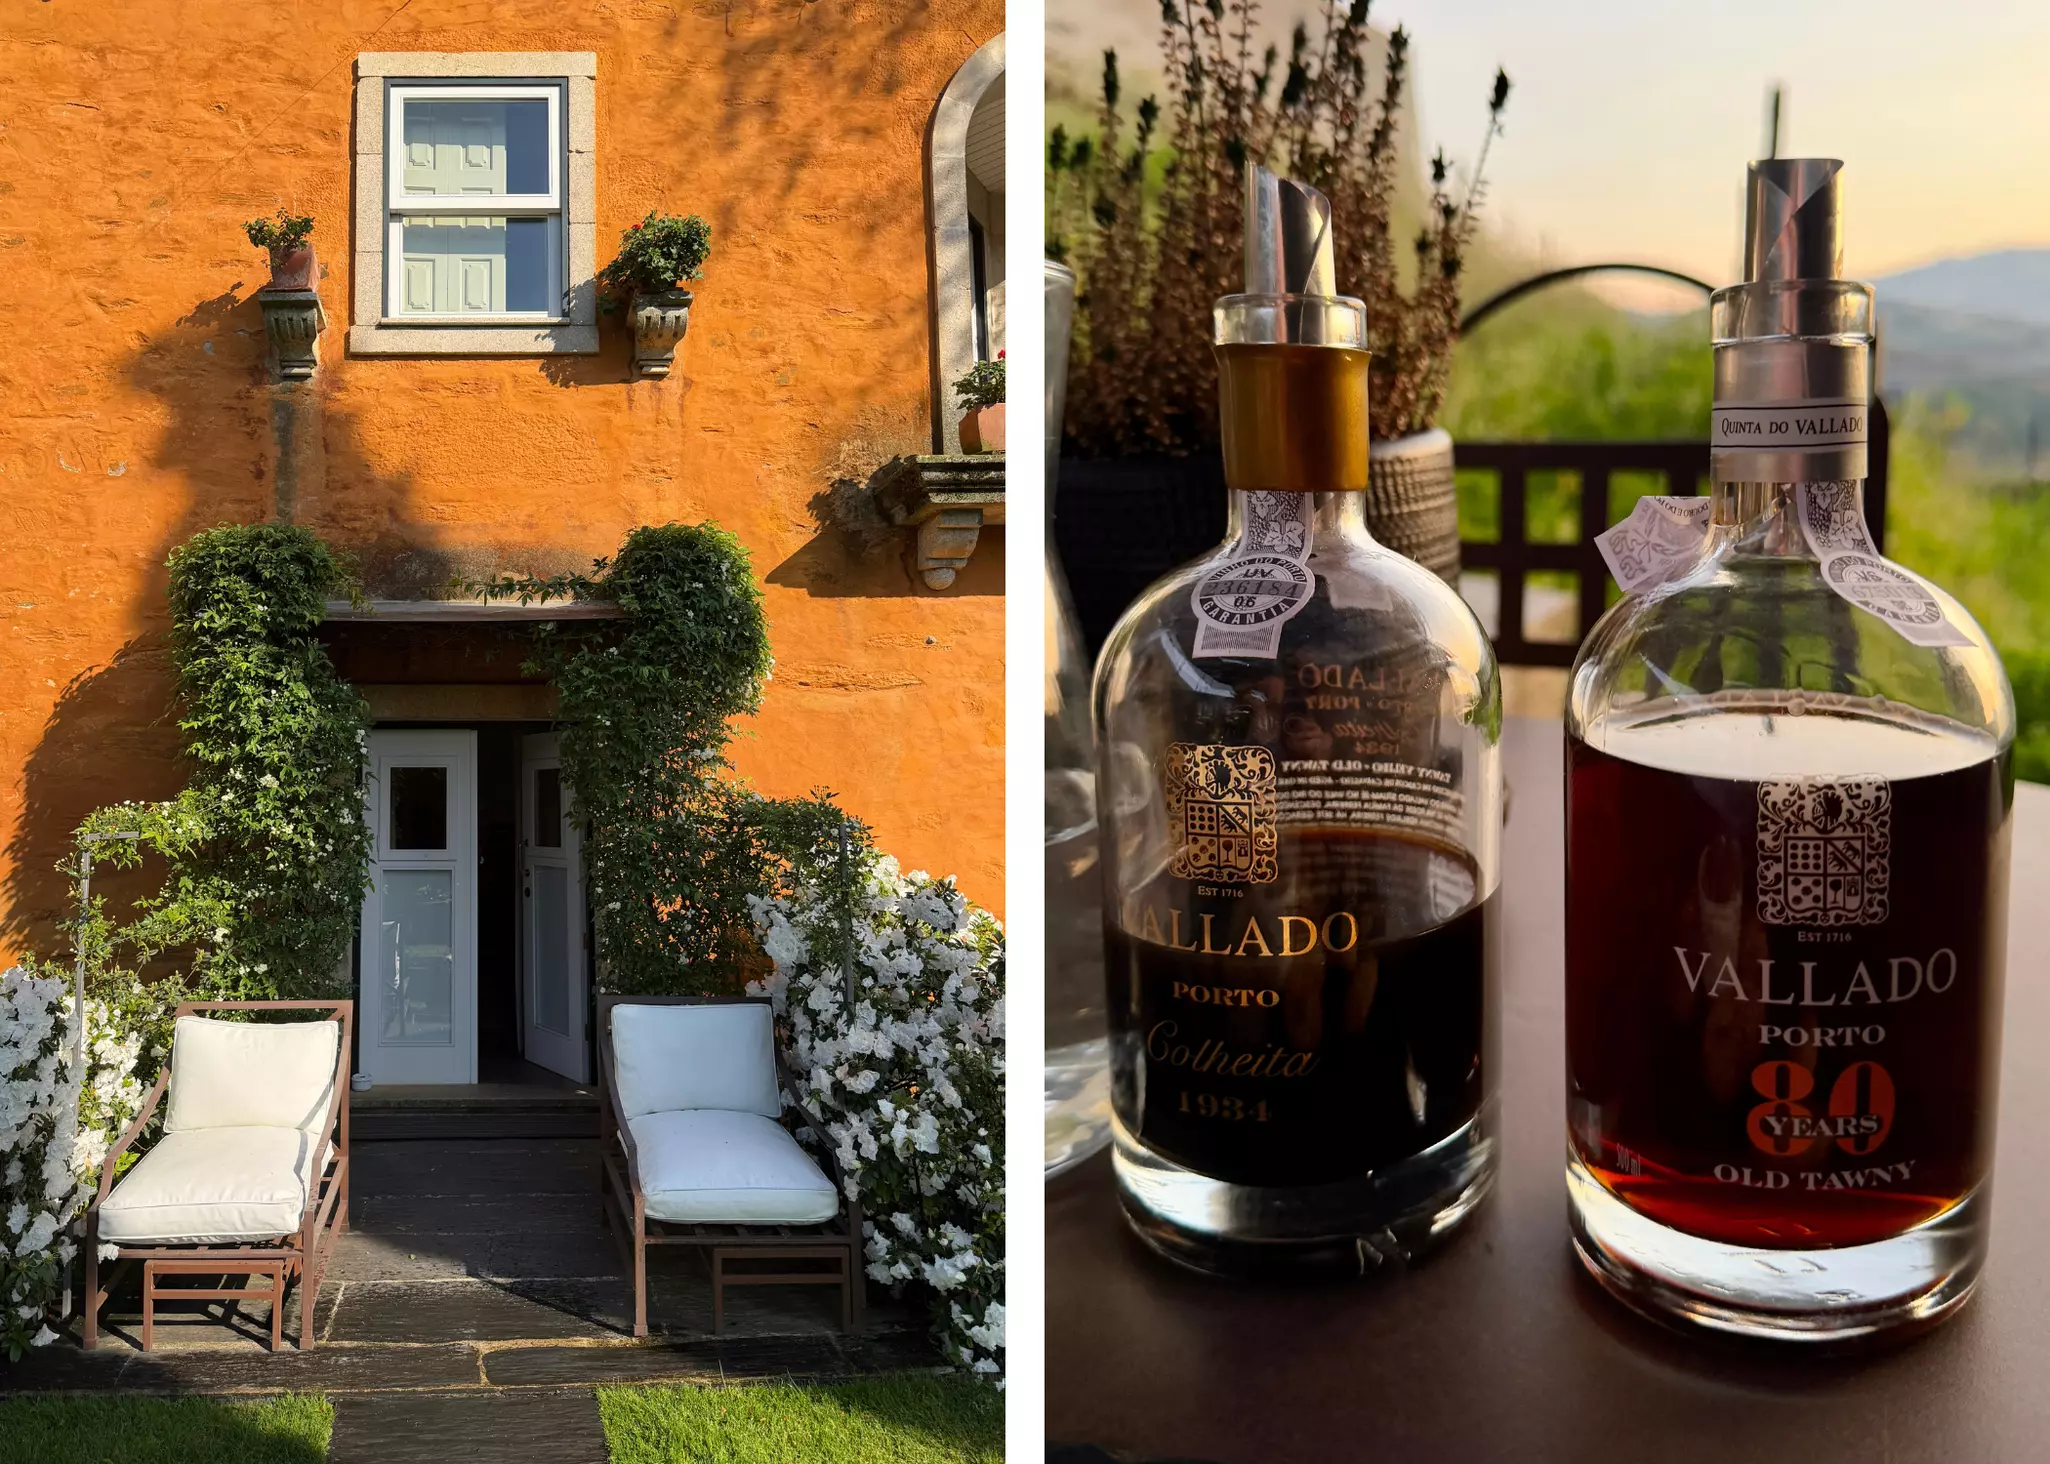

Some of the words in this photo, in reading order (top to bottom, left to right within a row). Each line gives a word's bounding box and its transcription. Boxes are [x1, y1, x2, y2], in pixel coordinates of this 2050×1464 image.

[1720, 416, 1761, 437] QUINTA
[1768, 419, 1789, 434] DO
[1794, 415, 1864, 435] VALLADO
[1207, 558, 1249, 581] VINHO
[1254, 556, 1273, 564] DO
[1278, 558, 1307, 582] PORTO
[1202, 599, 1291, 625] GARANTIA
[1197, 885, 1219, 897] EST
[1221, 887, 1244, 900] 1716
[1138, 903, 1359, 957] ALLADO
[1797, 930, 1823, 943] EST
[1826, 931, 1852, 943] 1716
[1673, 945, 1958, 1007] VALLADO
[1172, 981, 1281, 1008] PORTO
[1146, 1019, 1320, 1078] Colheita
[1758, 1023, 1887, 1048] PORTO
[1178, 1090, 1274, 1122] 1934
[1747, 1060, 1896, 1157] 80
[1763, 1114, 1879, 1138] YEARS
[1713, 1162, 1790, 1191] OLD
[1800, 1159, 1917, 1192] TAWNY
